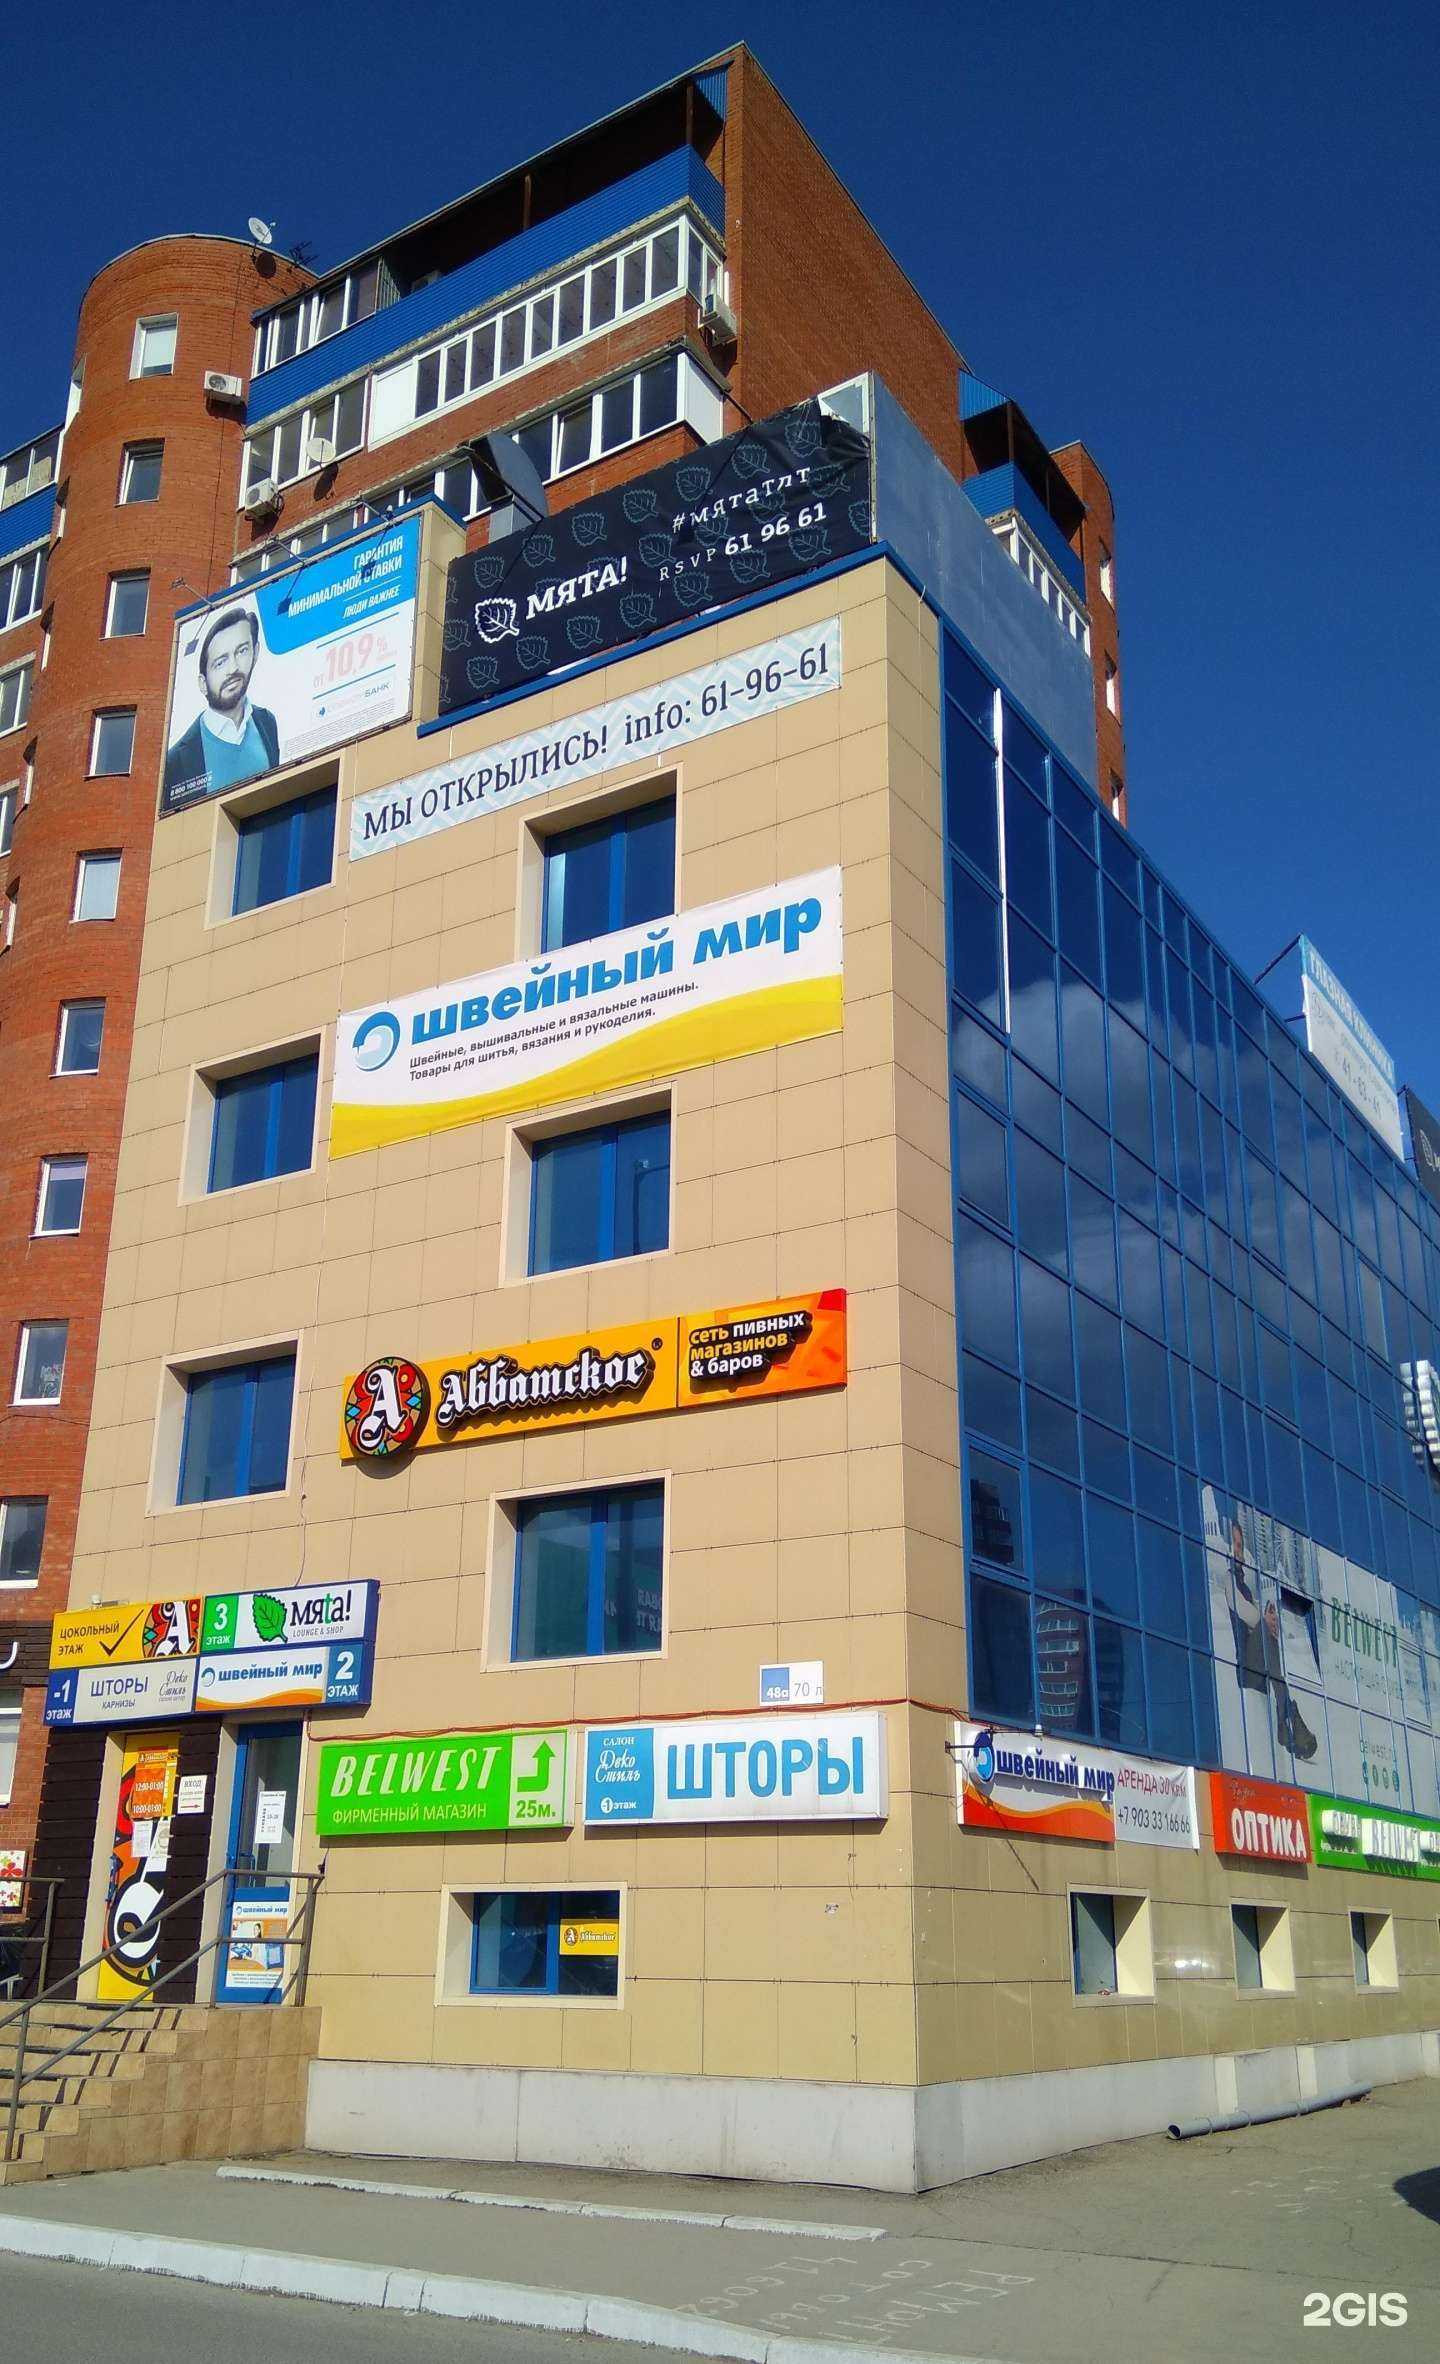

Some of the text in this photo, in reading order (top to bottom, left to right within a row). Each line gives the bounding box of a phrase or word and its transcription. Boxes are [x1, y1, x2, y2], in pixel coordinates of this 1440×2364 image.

[725, 533, 752, 555] 61
[761, 517, 790, 542] 96
[798, 502, 827, 527] 61
[354, 536, 403, 570] ГАРАНТИЯ
[288, 555, 403, 618] МИНИМАЛЬНОЙ СТАВКИ
[525, 556, 628, 621] МЯТА!
[343, 586, 400, 619] ЛЮДИ ВАЖНЕЕ
[363, 797, 412, 840] МЫ
[421, 726, 608, 818] ОТКРЫЛИСЬ!
[624, 700, 692, 745] info:
[701, 642, 829, 717] 61-96-61
[411, 897, 822, 1046] швейный мир
[409, 981, 699, 1069] Швейные, вышивальные и вязальные машины.
[409, 1008, 656, 1082] Товары для шитья, вязания и рукоделия.
[690, 1313, 805, 1344] сеть пивных
[690, 1333, 788, 1361] магазинов
[690, 1354, 763, 1378] & баров
[60, 1621, 120, 1639] ЦОКОЛЬНЫЙ
[214, 1603, 228, 1631] 3
[206, 1634, 230, 1646] этаж
[293, 1628, 319, 1638] LOUNGE
[326, 1626, 344, 1635] SHOP
[58, 1642, 84, 1656] ЭТАЖ
[218, 1660, 323, 1682] швейный мир
[335, 1651, 354, 1680] 2
[53, 1680, 70, 1704] -1
[91, 1677, 148, 1697] ШТОРЫ
[327, 1684, 359, 1698] ЭТАЖ
[794, 1682, 810, 1697] 70
[46, 1708, 73, 1721] этаж
[102, 1699, 135, 1710] КАРНИЗЫ
[603, 1736, 635, 1746] САЛОН
[331, 1747, 503, 1798] BELWEST
[595, 1764, 640, 1783] Стиль
[667, 1735, 864, 1801] ШТОРЫ
[996, 1748, 1115, 1802] швейный мир
[1117, 1768, 1158, 1796] АРЕНДА
[1160, 1778, 1170, 1796] 30
[332, 1801, 487, 1825] ФИРМЕННЫЙ МАГАЗИН
[613, 1801, 637, 1809] этаж
[1118, 1806, 1129, 1825] +7
[1131, 1808, 1150, 1830] 903
[1152, 1811, 1163, 1831] 33
[1232, 1807, 1307, 1858] ОПТИКА
